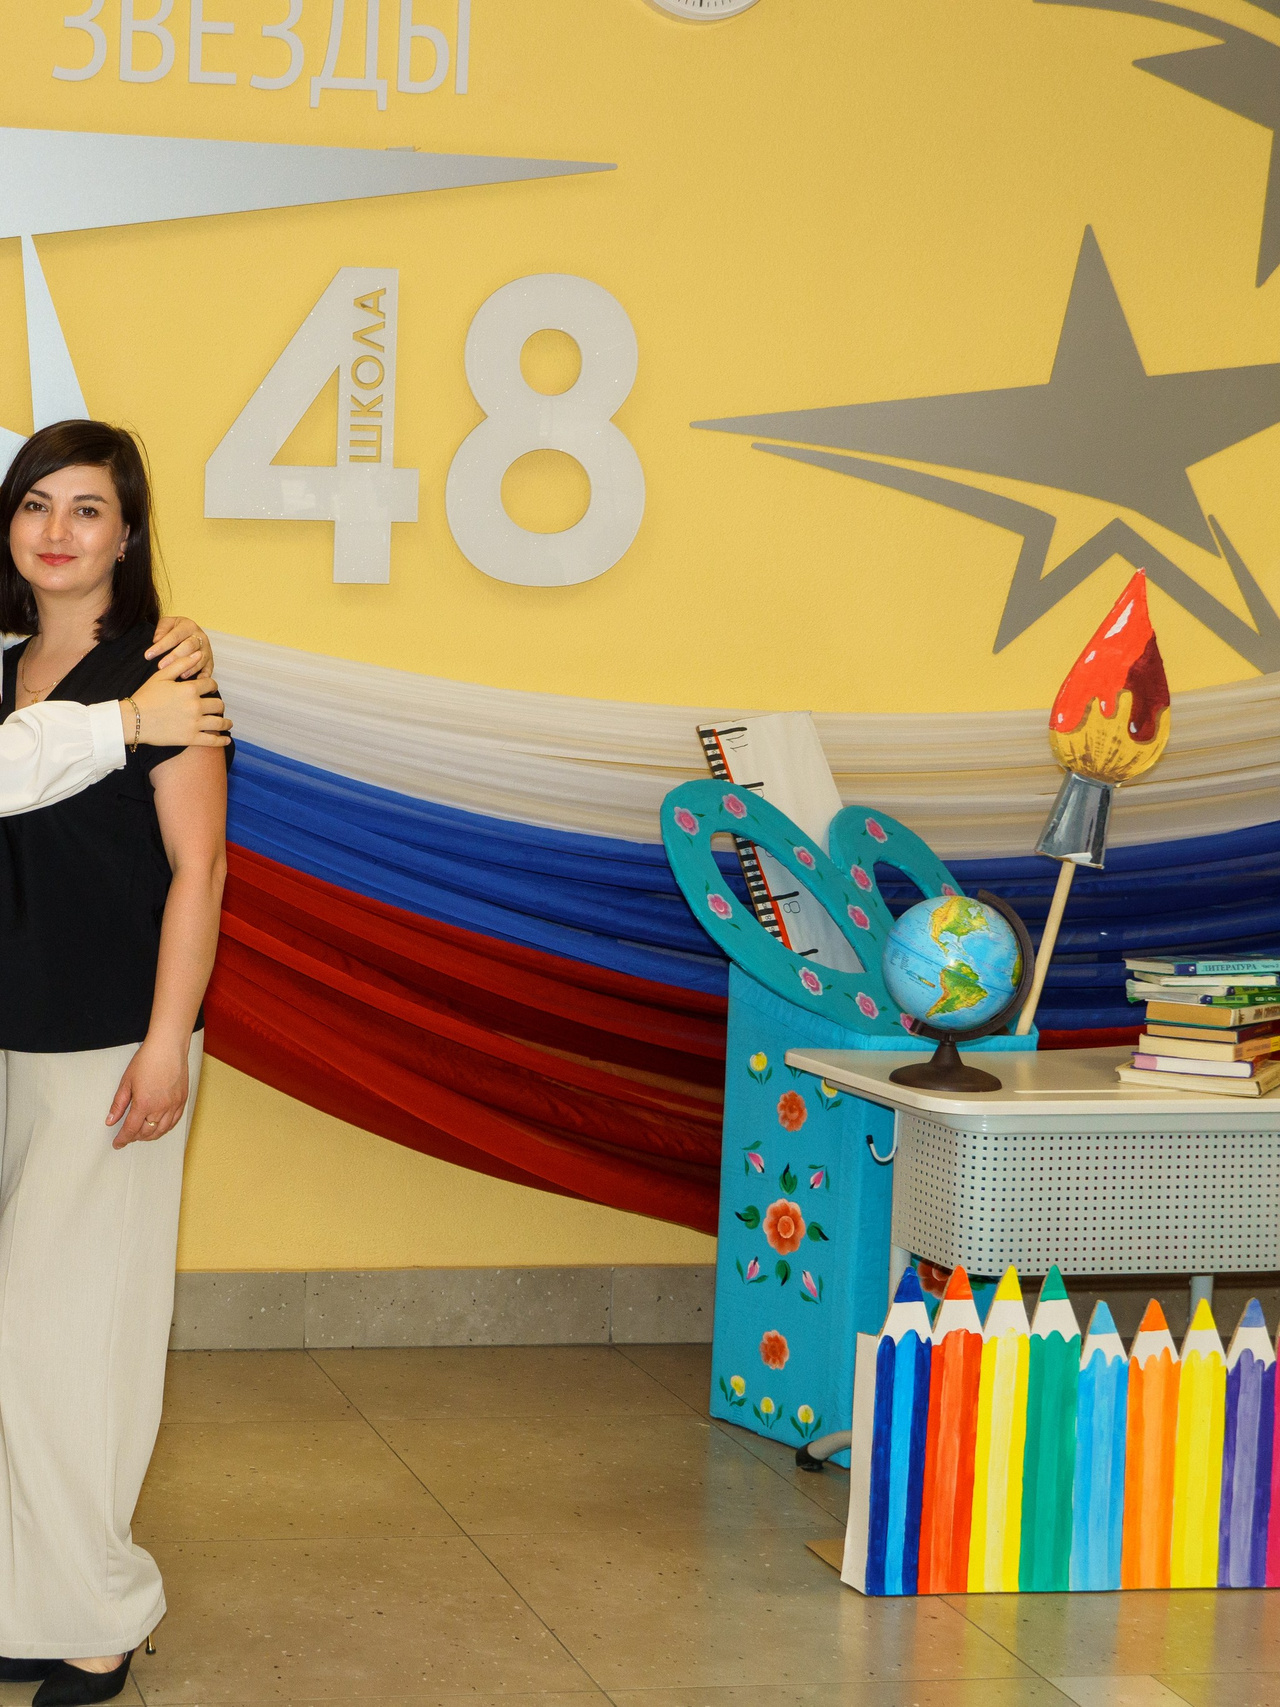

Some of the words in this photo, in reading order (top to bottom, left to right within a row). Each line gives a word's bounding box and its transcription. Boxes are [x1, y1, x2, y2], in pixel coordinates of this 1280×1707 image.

[52, 0, 469, 111] ЗВЕЗДЫ
[204, 266, 646, 588] 48
[348, 287, 387, 464] ШКОЛА
[782, 900, 801, 914] 8
[1201, 963, 1257, 972] ЛИТЕРАТУРА
